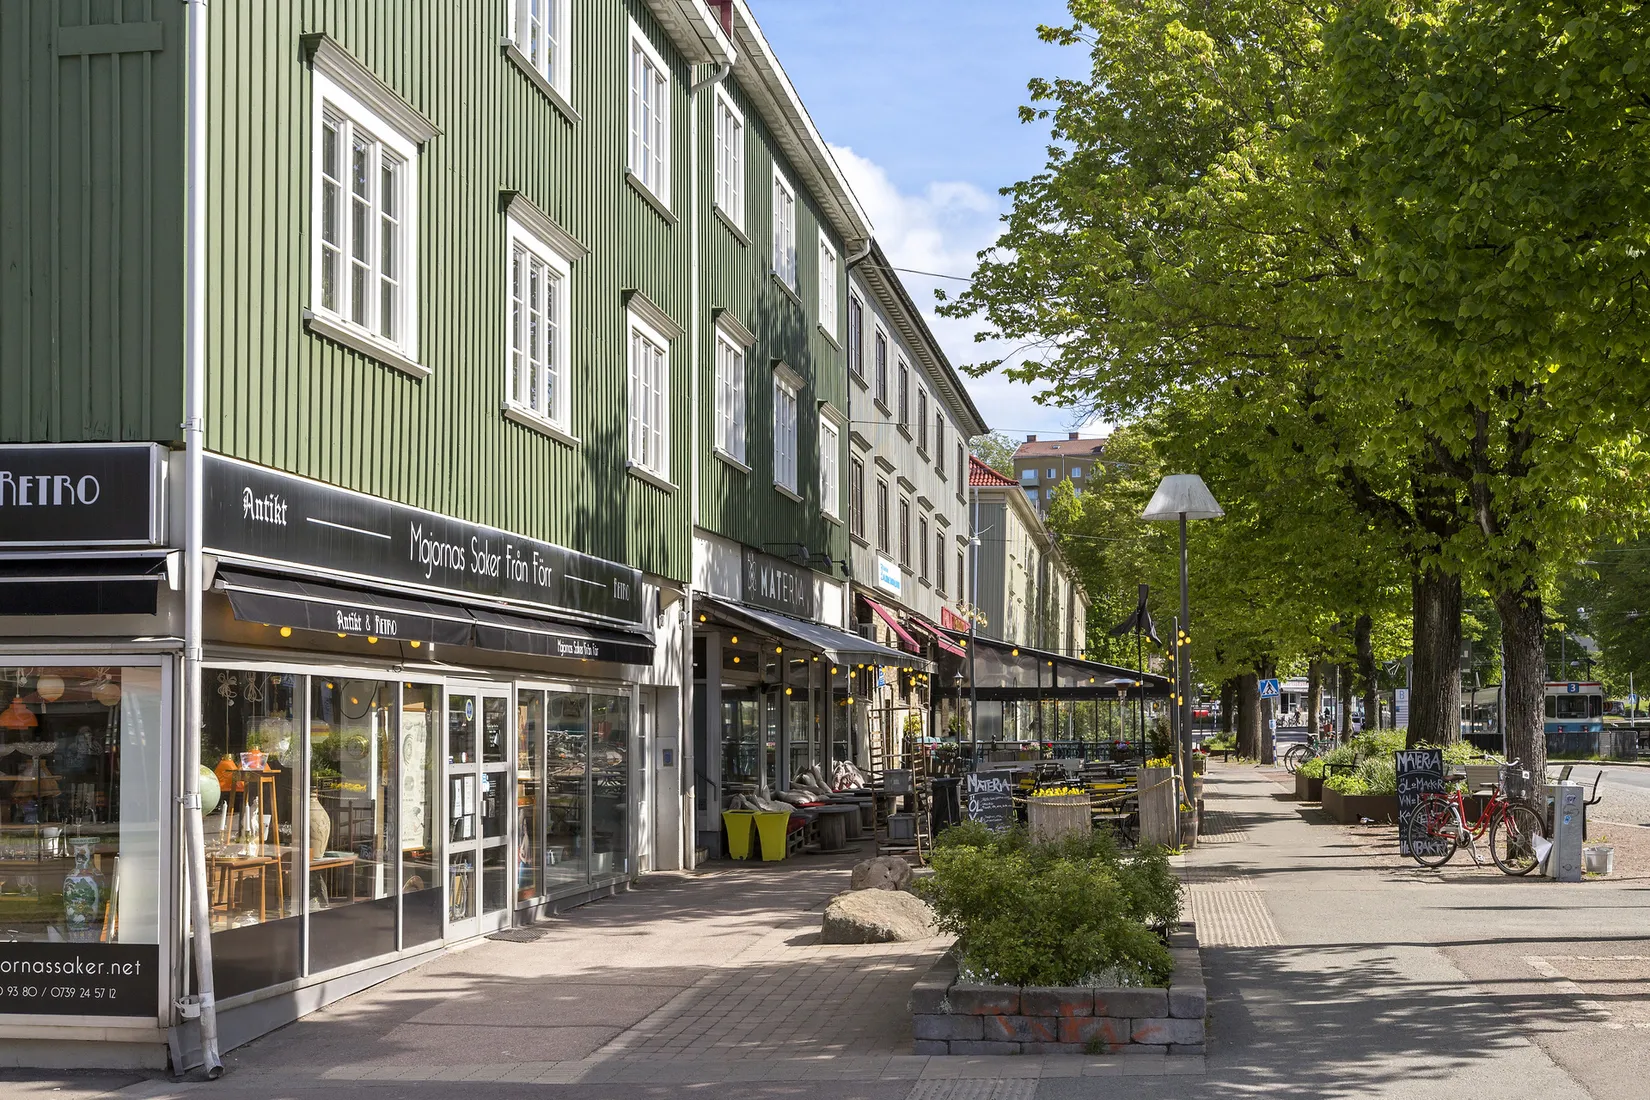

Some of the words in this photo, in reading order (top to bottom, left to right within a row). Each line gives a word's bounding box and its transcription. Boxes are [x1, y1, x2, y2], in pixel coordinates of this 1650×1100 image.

[243, 487, 288, 526] Antikt
[410, 521, 466, 579] Majornas
[471, 536, 502, 577] Saker
[506, 545, 529, 583] Från
[533, 552, 552, 588] Förr
[760, 565, 805, 606] MATERIA
[336, 609, 362, 631] Antikt
[365, 614, 371, 631] &
[1570, 684, 1576, 692] 3
[7, 986, 19, 997] 93
[22, 986, 38, 998] 80
[50, 986, 76, 998] 0739
[79, 987, 91, 998] 24
[94, 988, 106, 998] 57
[108, 988, 117, 999] 12
